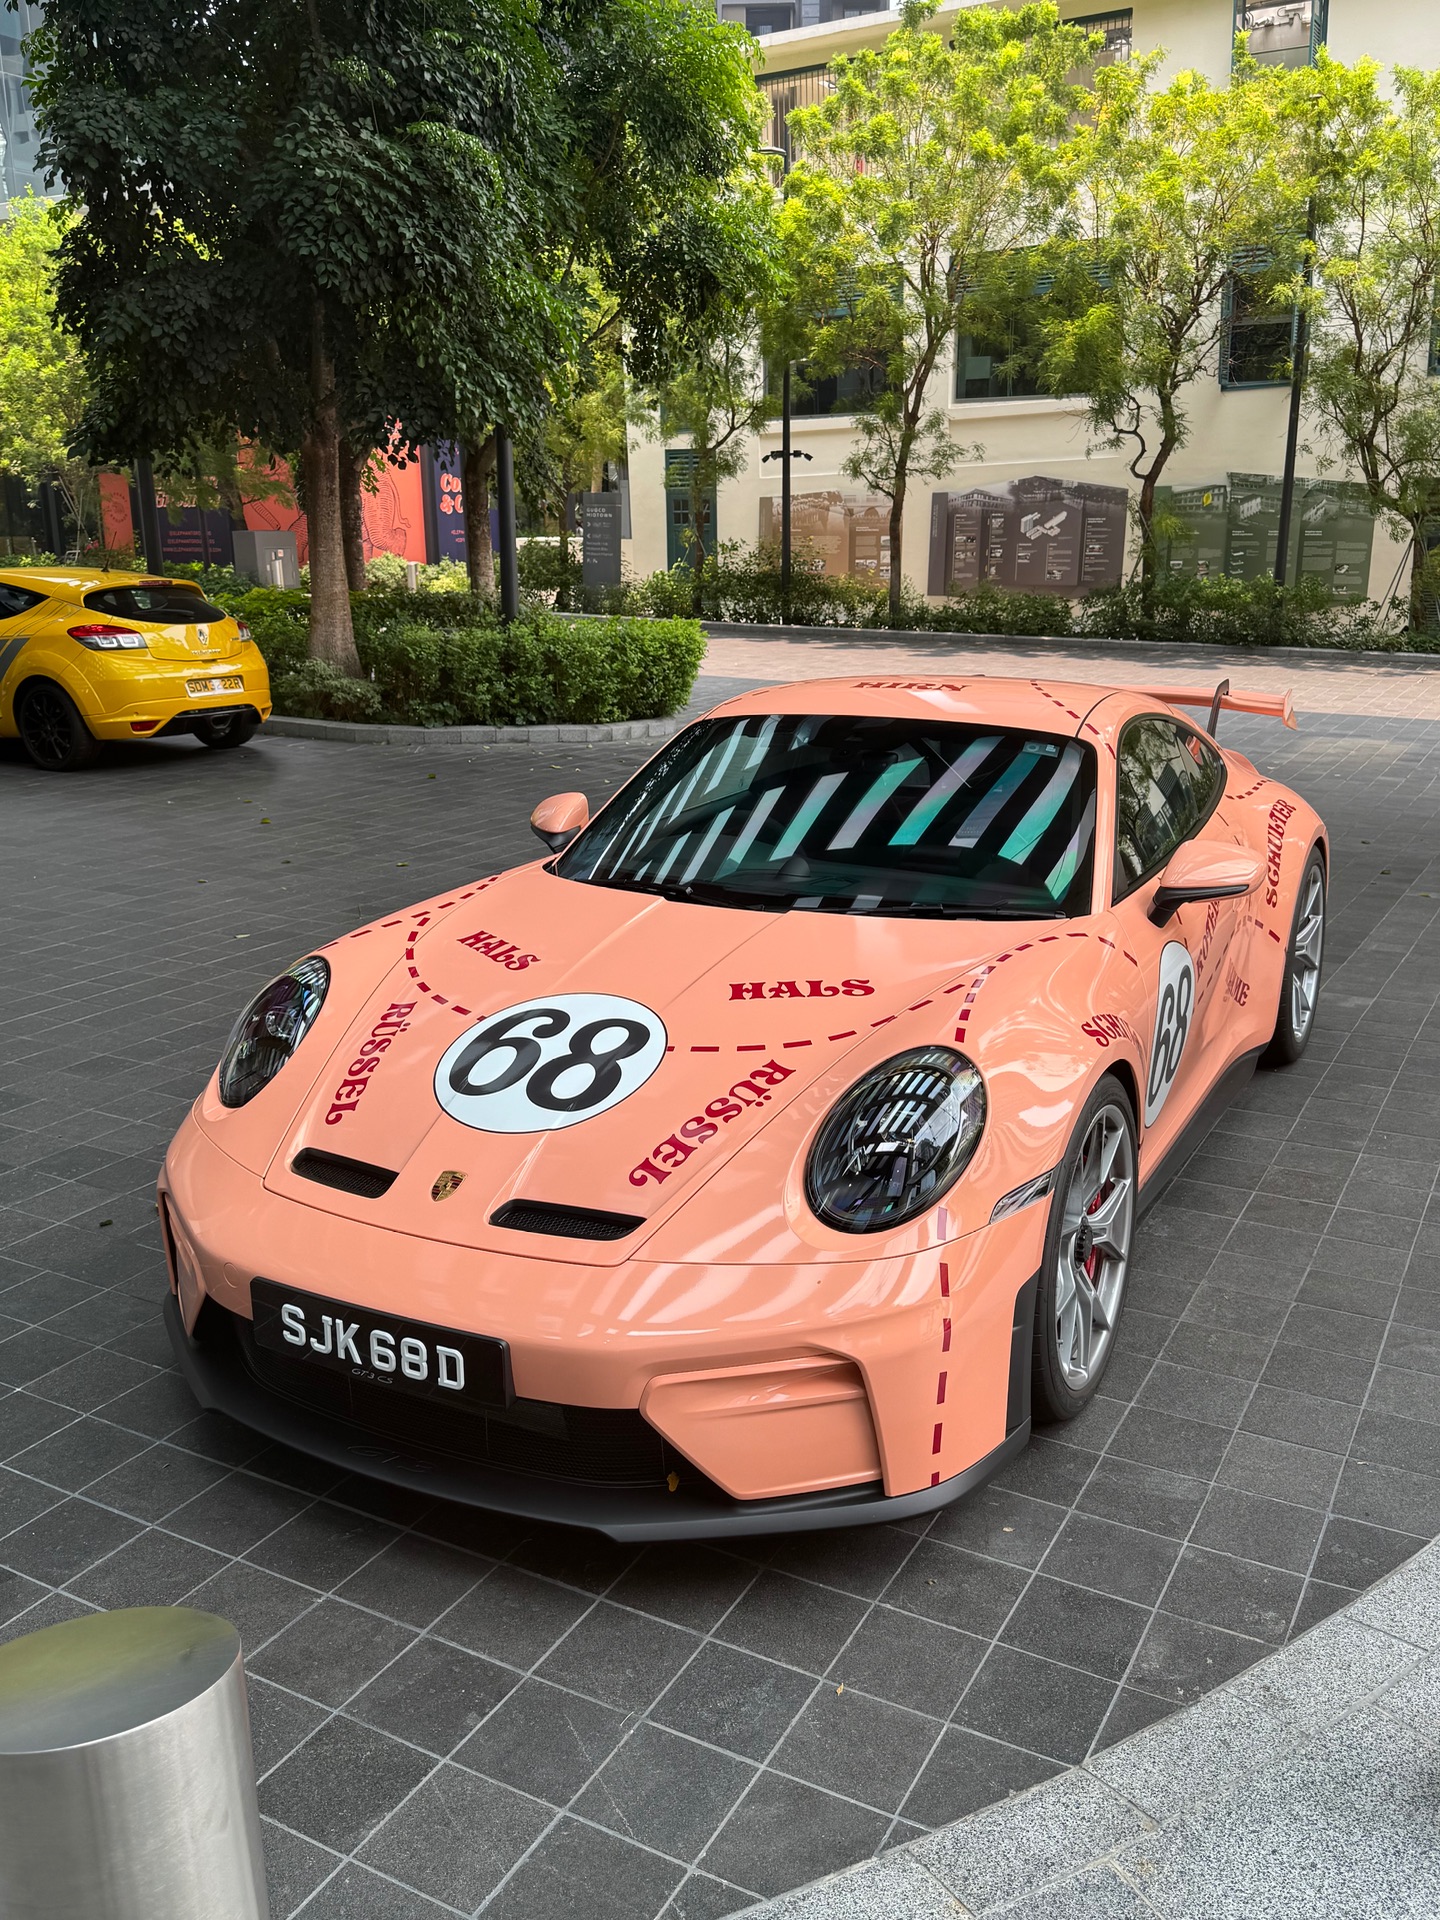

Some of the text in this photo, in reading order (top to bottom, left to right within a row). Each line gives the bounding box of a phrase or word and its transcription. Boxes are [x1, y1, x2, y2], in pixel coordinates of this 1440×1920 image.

[852, 682, 973, 692] HIRN
[1266, 799, 1296, 909] SCHULTER
[457, 930, 541, 971] HALS
[729, 979, 875, 1001] HALS
[322, 1001, 418, 1126] RÜSSEL
[448, 1007, 651, 1113] 68
[1147, 965, 1192, 1108] 68
[628, 1059, 796, 1188] RÜSSEL
[351, 1367, 376, 1380] GT3
